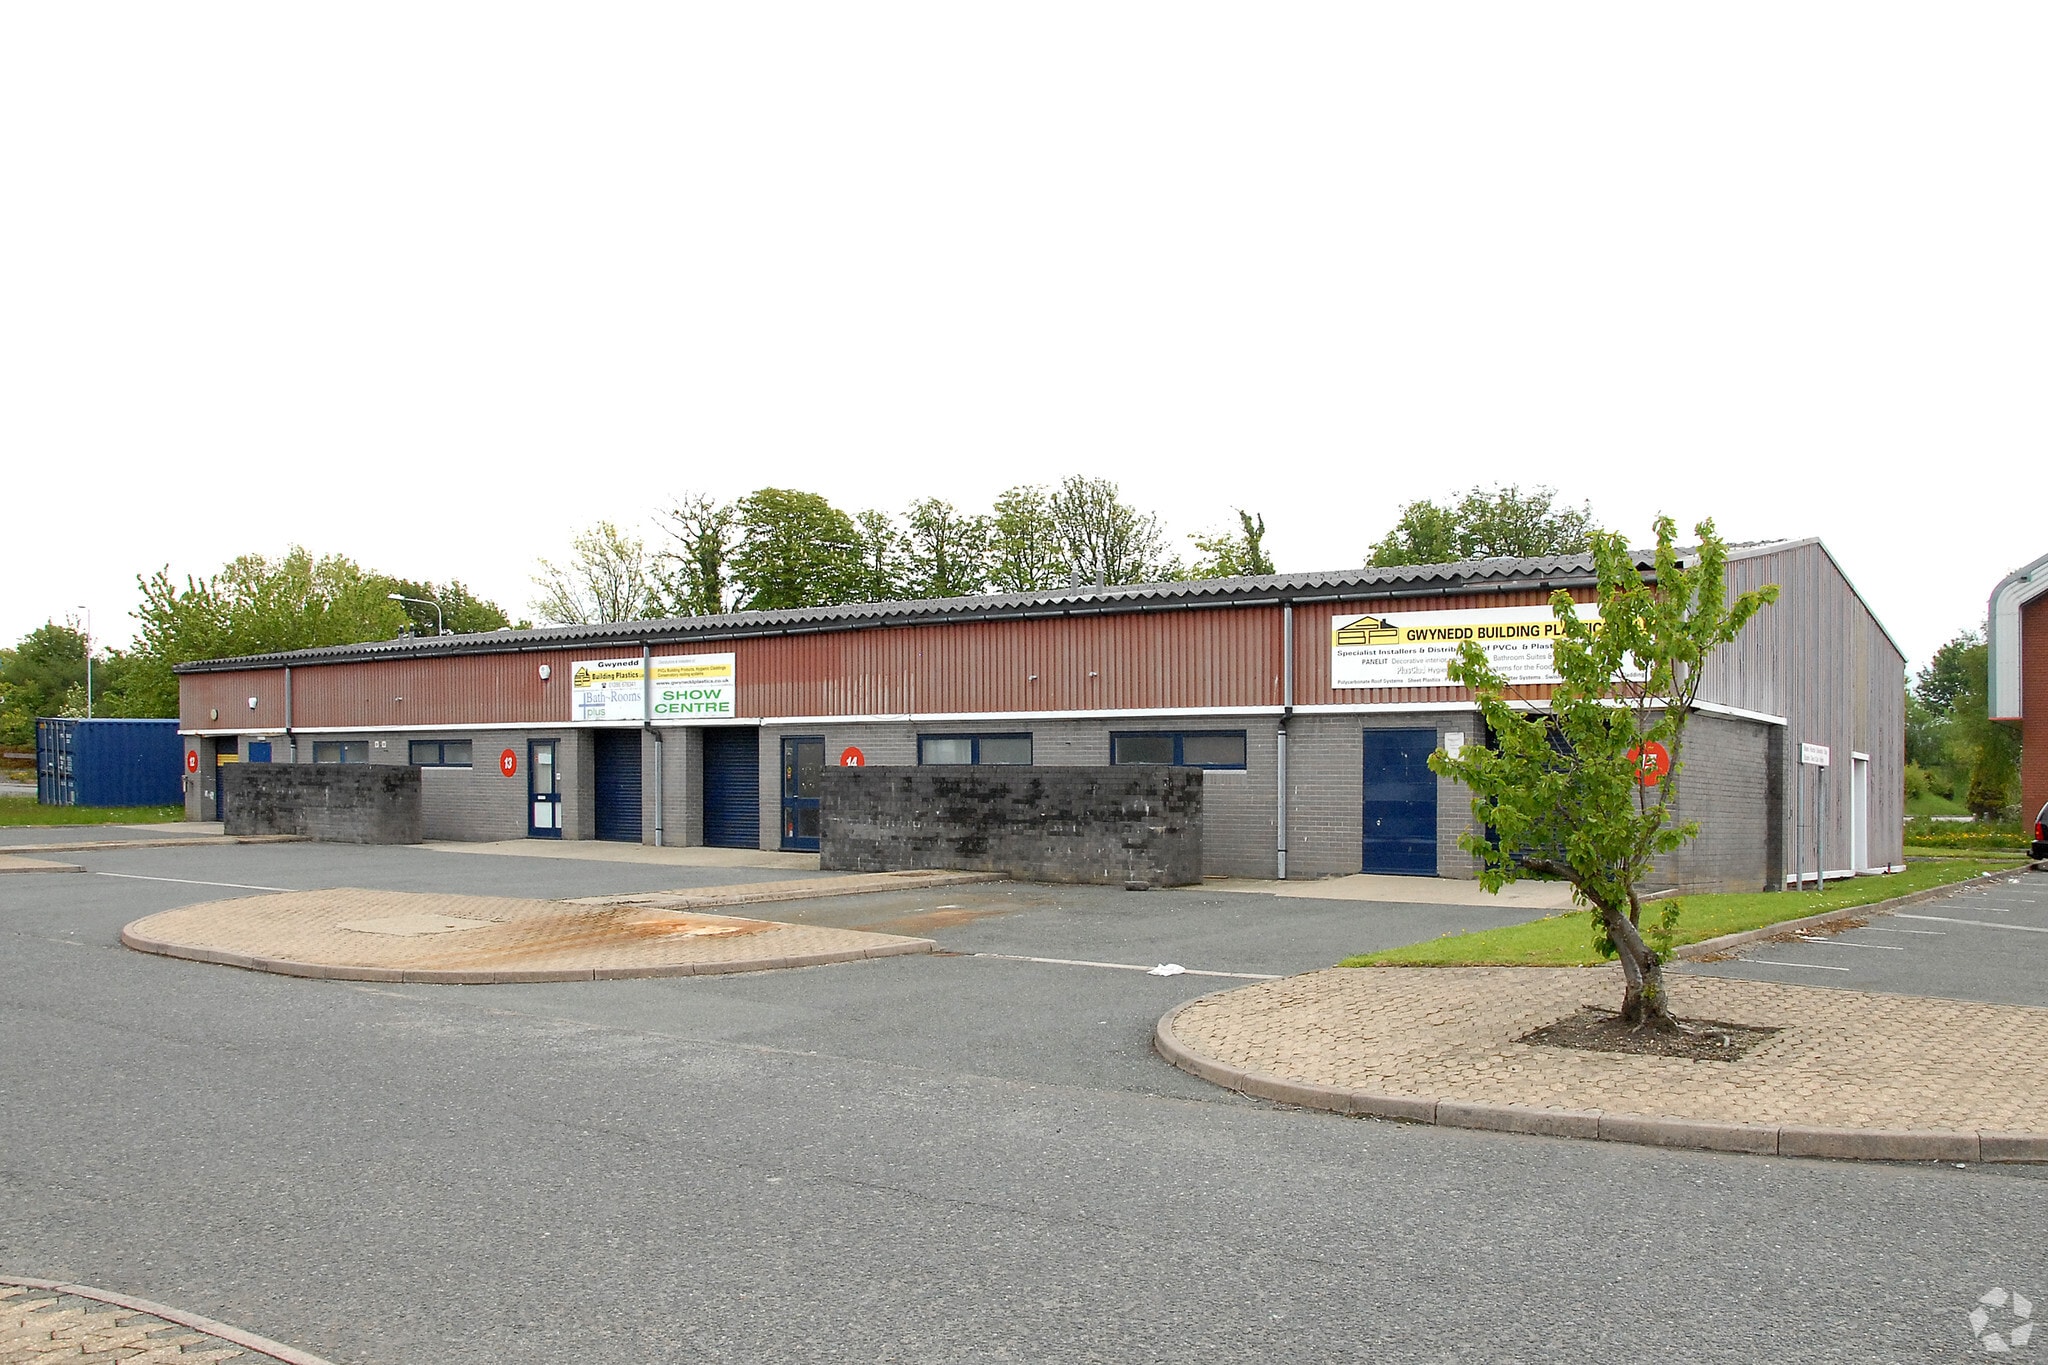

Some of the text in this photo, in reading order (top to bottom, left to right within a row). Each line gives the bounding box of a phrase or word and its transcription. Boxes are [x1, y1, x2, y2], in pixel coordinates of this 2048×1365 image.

[1407, 627, 1473, 641] GWYNEDD
[1478, 625, 1540, 639] BUILDING
[1337, 649, 1377, 657] Specialist
[598, 660, 639, 668] Gwynedd
[1391, 657, 1424, 665] Decorative
[1536, 663, 1553, 671] Food
[592, 673, 615, 681] Building
[616, 671, 639, 679] Plastics
[663, 689, 722, 701] SHOW
[654, 702, 730, 714] CENTRE
[587, 708, 606, 719] plus
[504, 757, 513, 769] 13
[846, 756, 857, 766] 14
